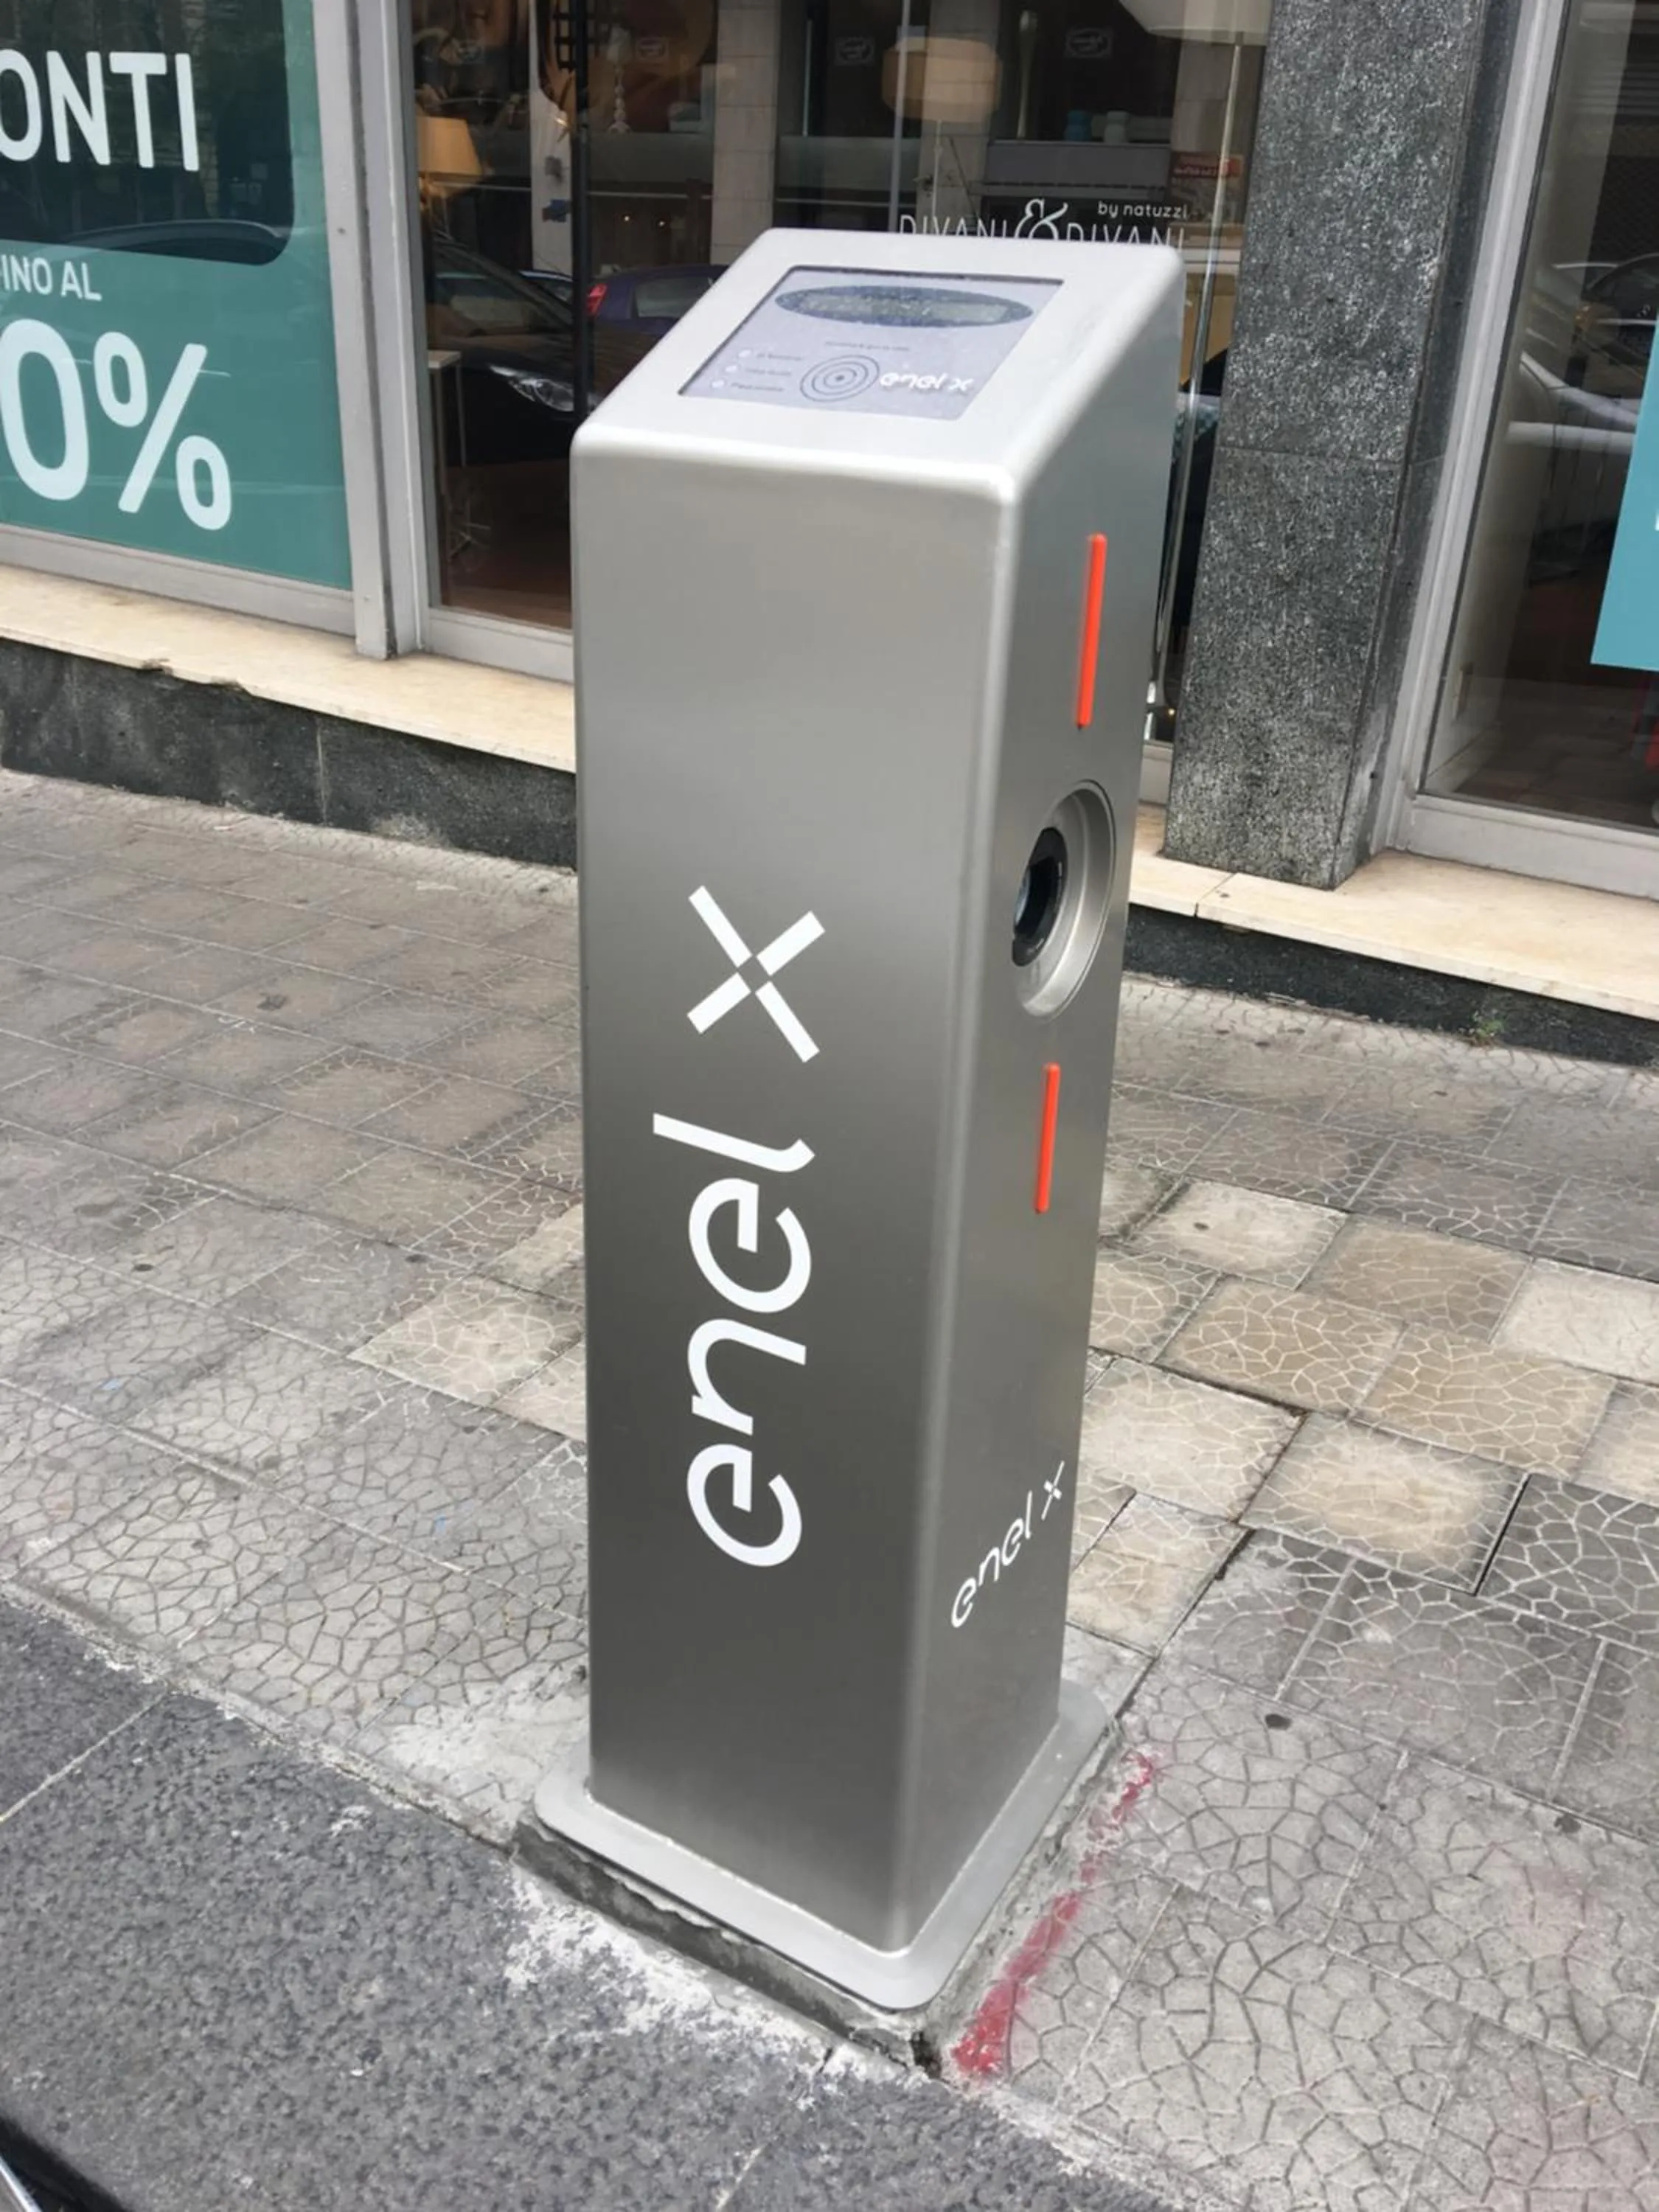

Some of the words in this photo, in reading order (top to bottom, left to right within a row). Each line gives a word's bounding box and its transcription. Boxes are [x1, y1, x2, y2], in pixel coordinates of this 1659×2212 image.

[0, 49, 200, 172] ONTI
[1097, 201, 1119, 218] by
[1124, 204, 1189, 220] natuzzi
[0, 254, 53, 296] INO
[60, 260, 102, 302] AL
[0, 318, 232, 530] 0%
[879, 372, 947, 390] enel
[653, 1113, 815, 1566] enel
[951, 1490, 1033, 1628] enel
